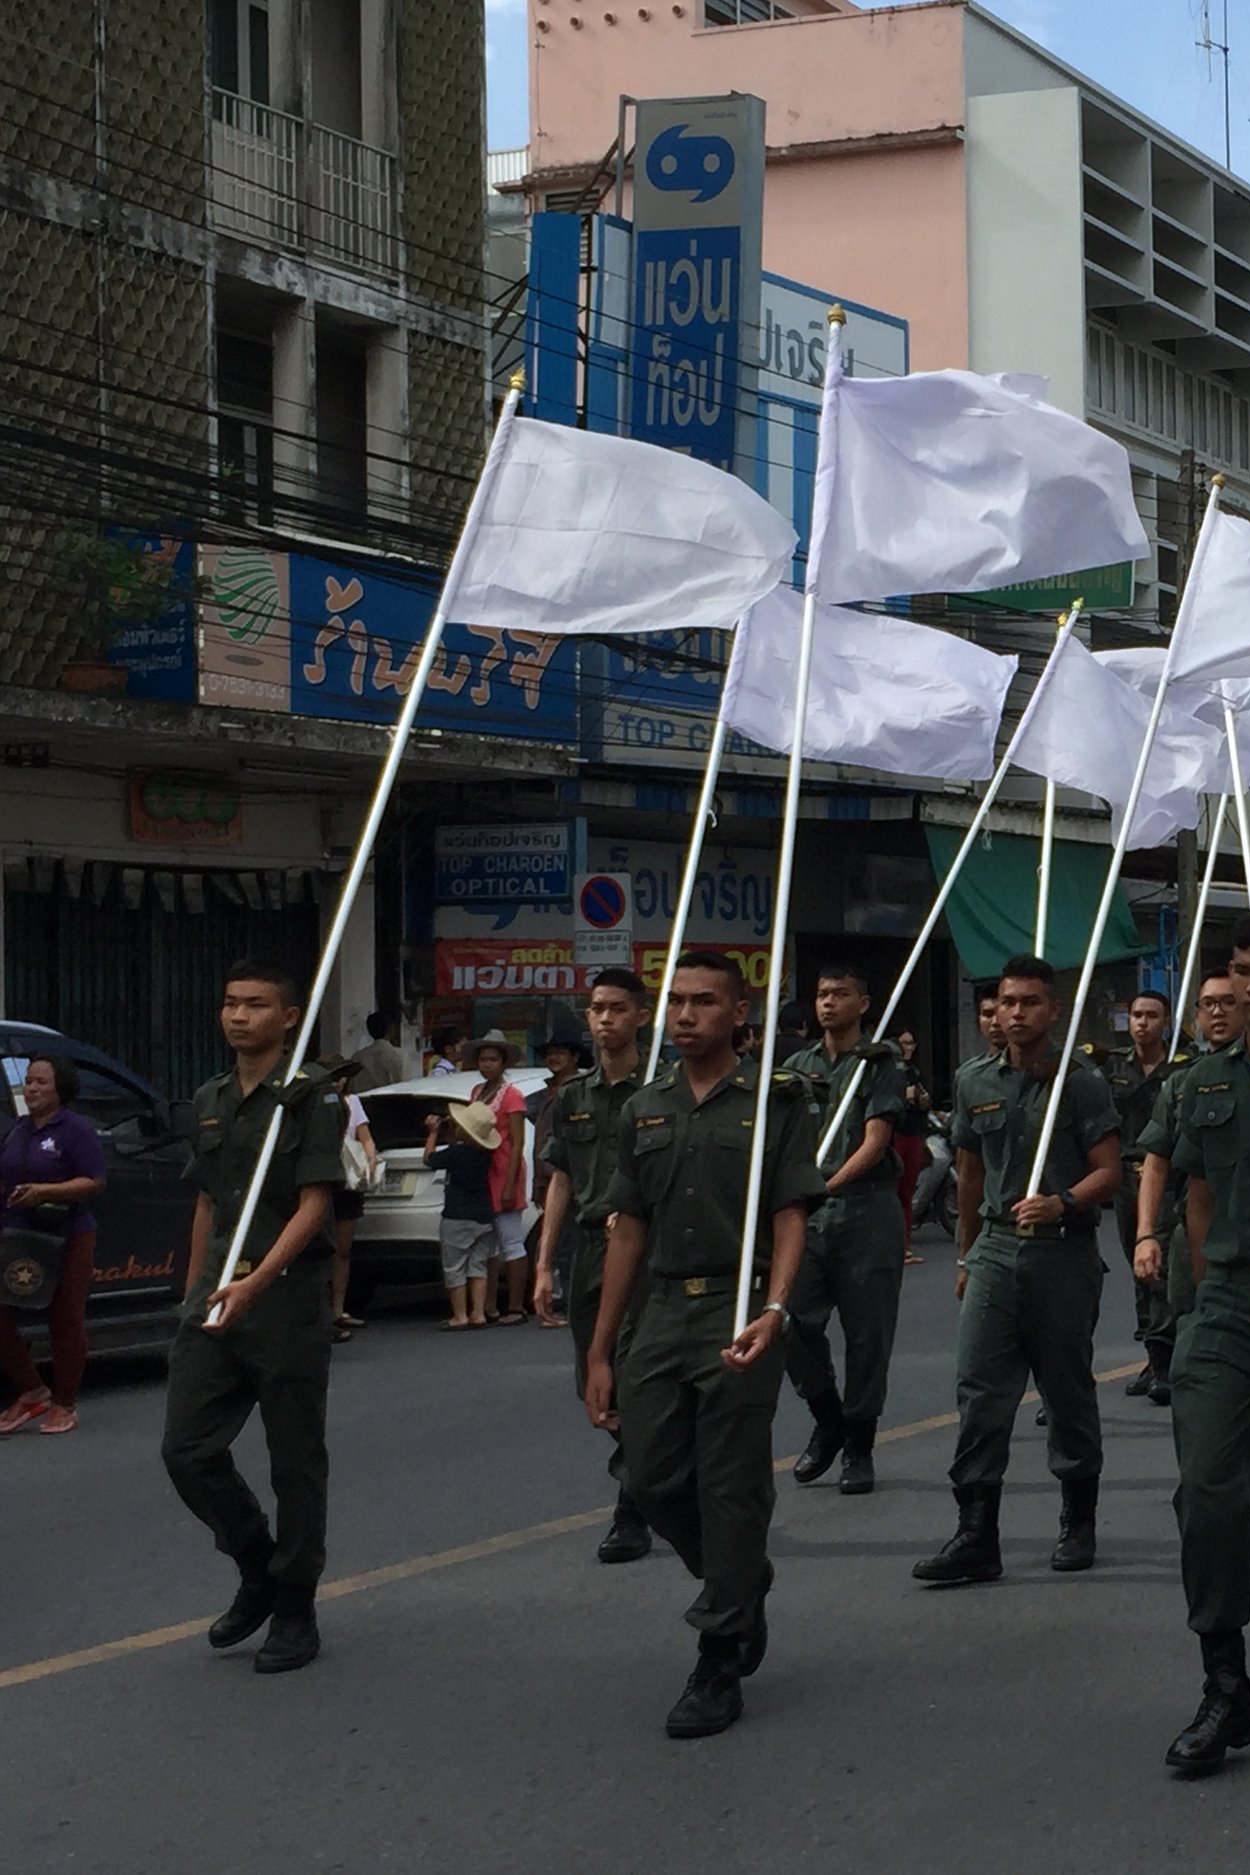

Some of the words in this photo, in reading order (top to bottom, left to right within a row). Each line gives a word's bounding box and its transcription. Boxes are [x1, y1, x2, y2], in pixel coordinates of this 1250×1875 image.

[645, 240, 731, 327] แว่น
[617, 714, 676, 747] TOP
[439, 856, 473, 873] TOP
[484, 855, 565, 873] CHAROEN
[451, 877, 551, 896] OPTICAL
[452, 959, 575, 990] แว่นตา
